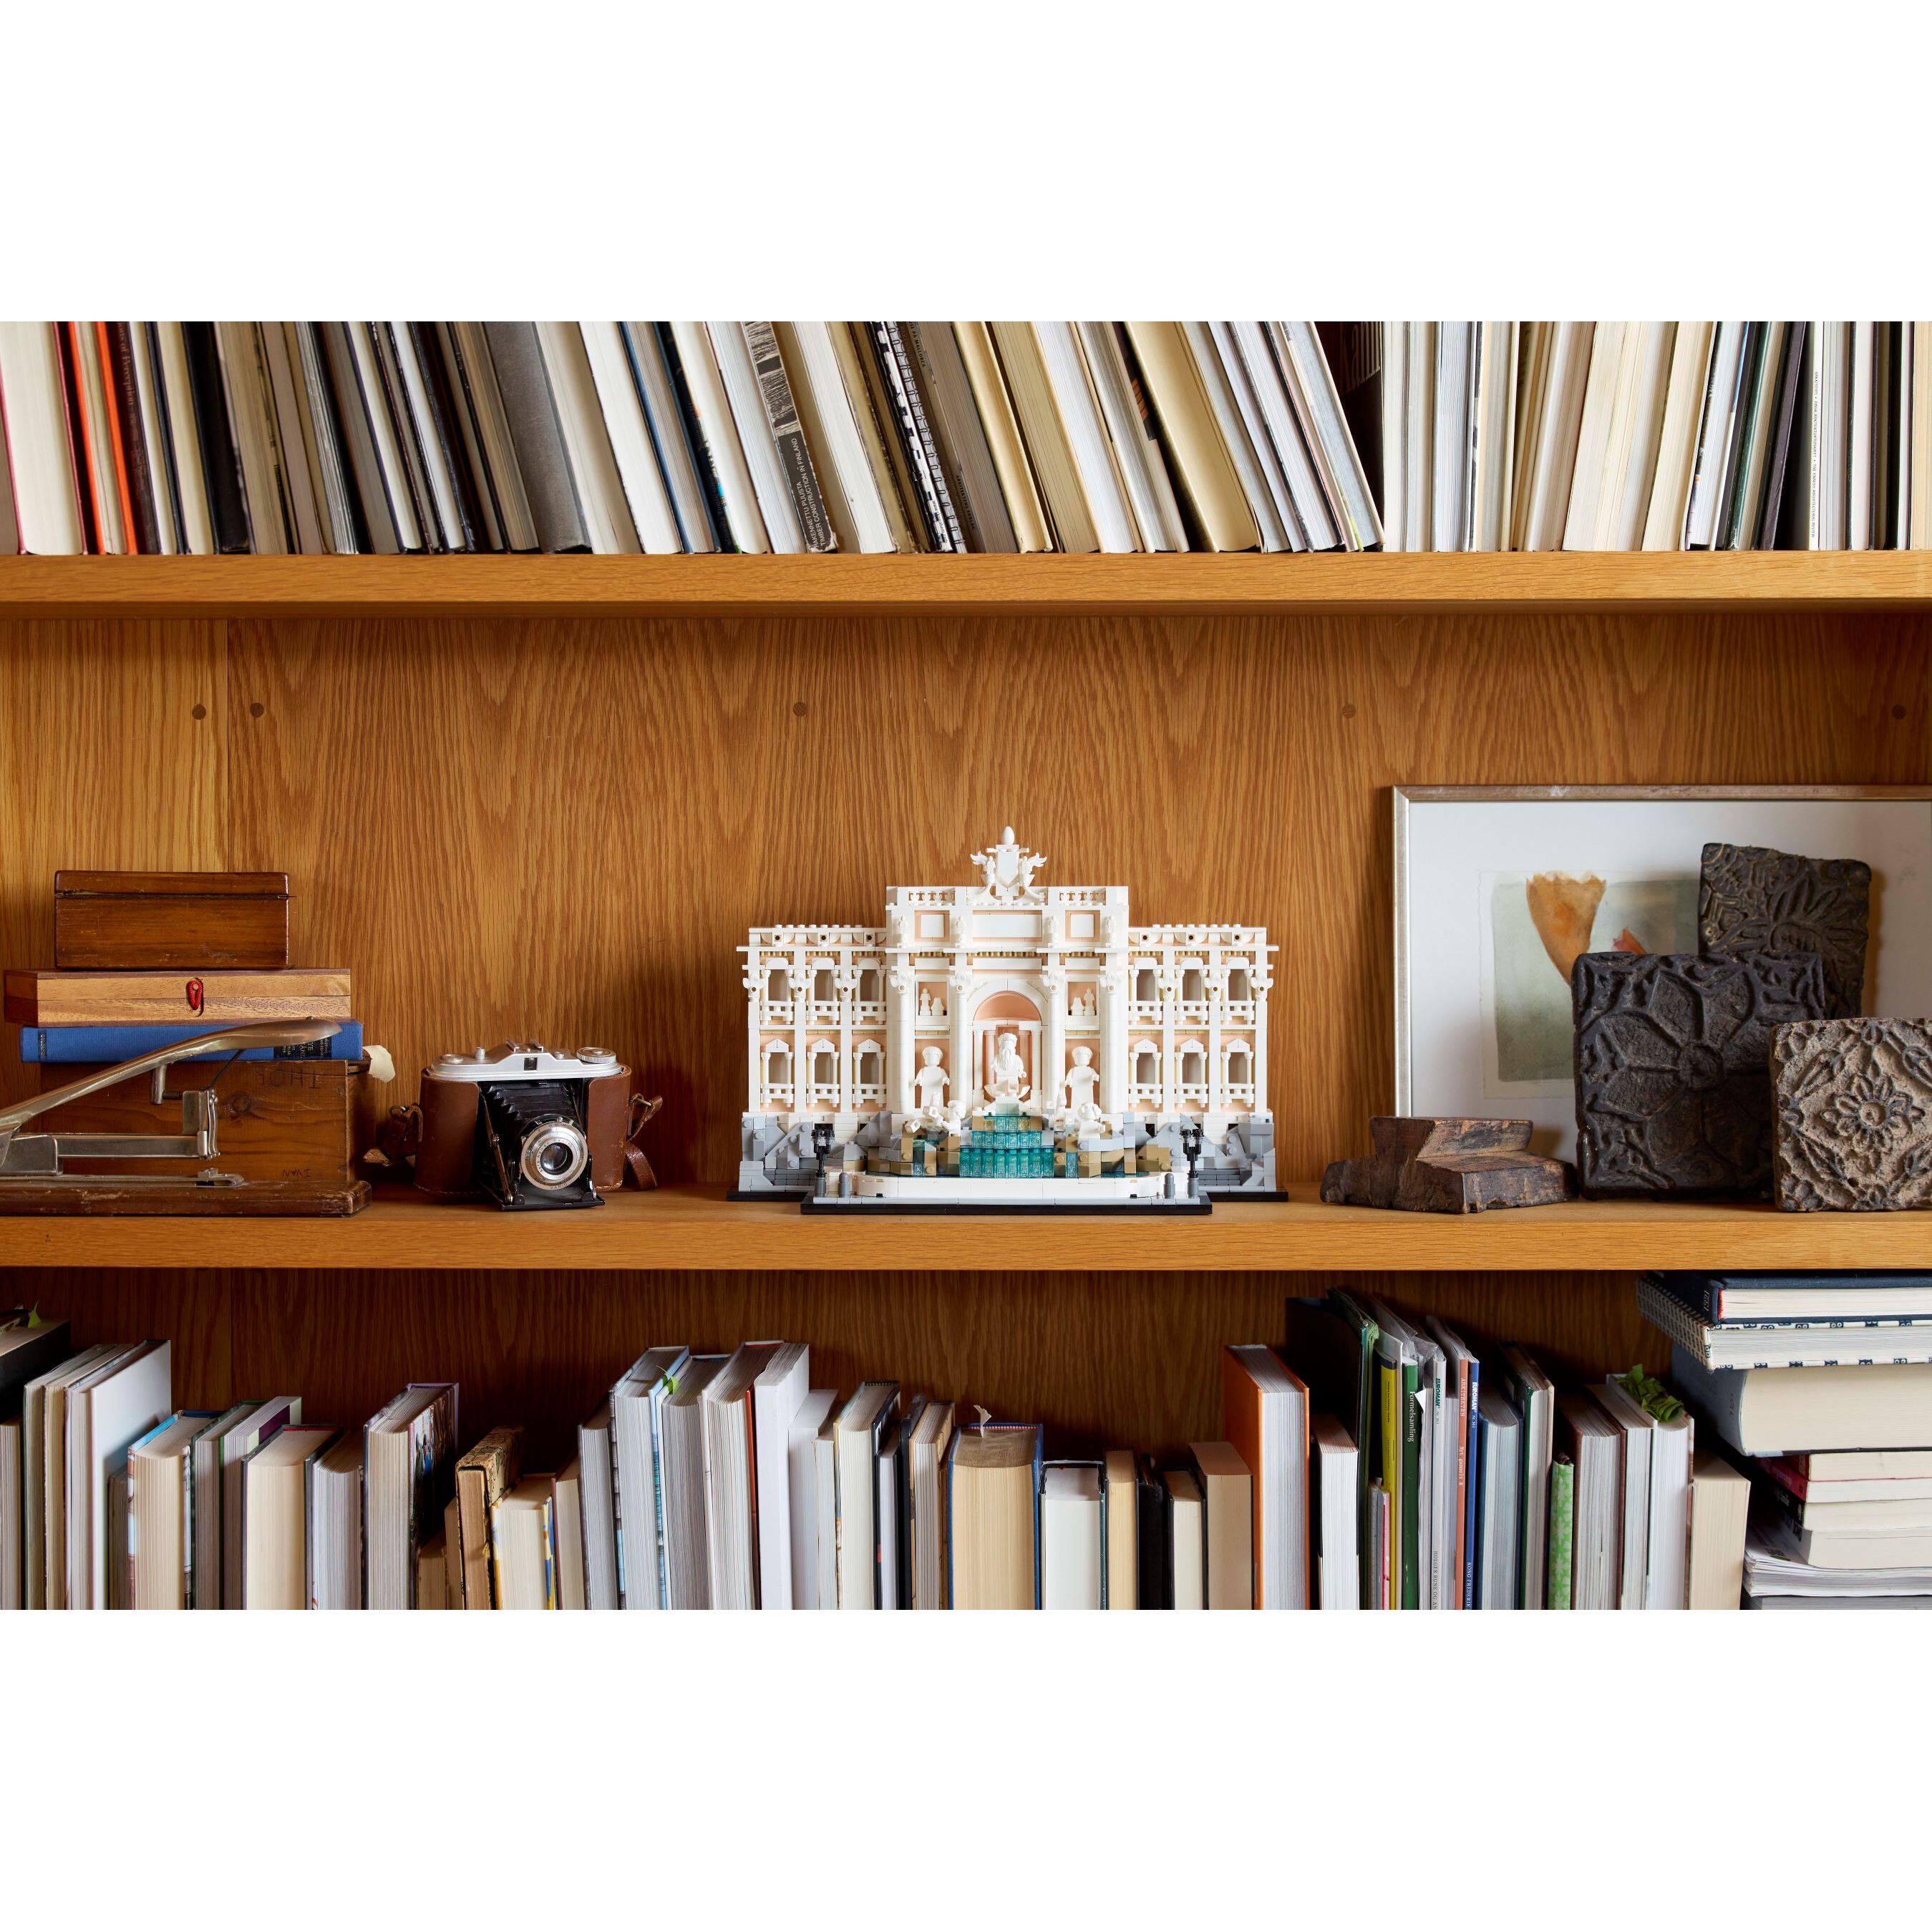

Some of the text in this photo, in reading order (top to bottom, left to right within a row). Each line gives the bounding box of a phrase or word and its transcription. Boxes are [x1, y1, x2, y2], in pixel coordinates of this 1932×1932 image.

[915, 339, 926, 367] MALLORCA
[122, 355, 136, 406] Perception
[791, 438, 804, 465] FINLAND
[797, 481, 807, 506] PUUSTA
[802, 472, 820, 522] CONSTRUCTION
[815, 522, 827, 545] TIMBER
[1407, 1391, 1416, 1443] Formelsamling
[1432, 1591, 1437, 1600] OG
